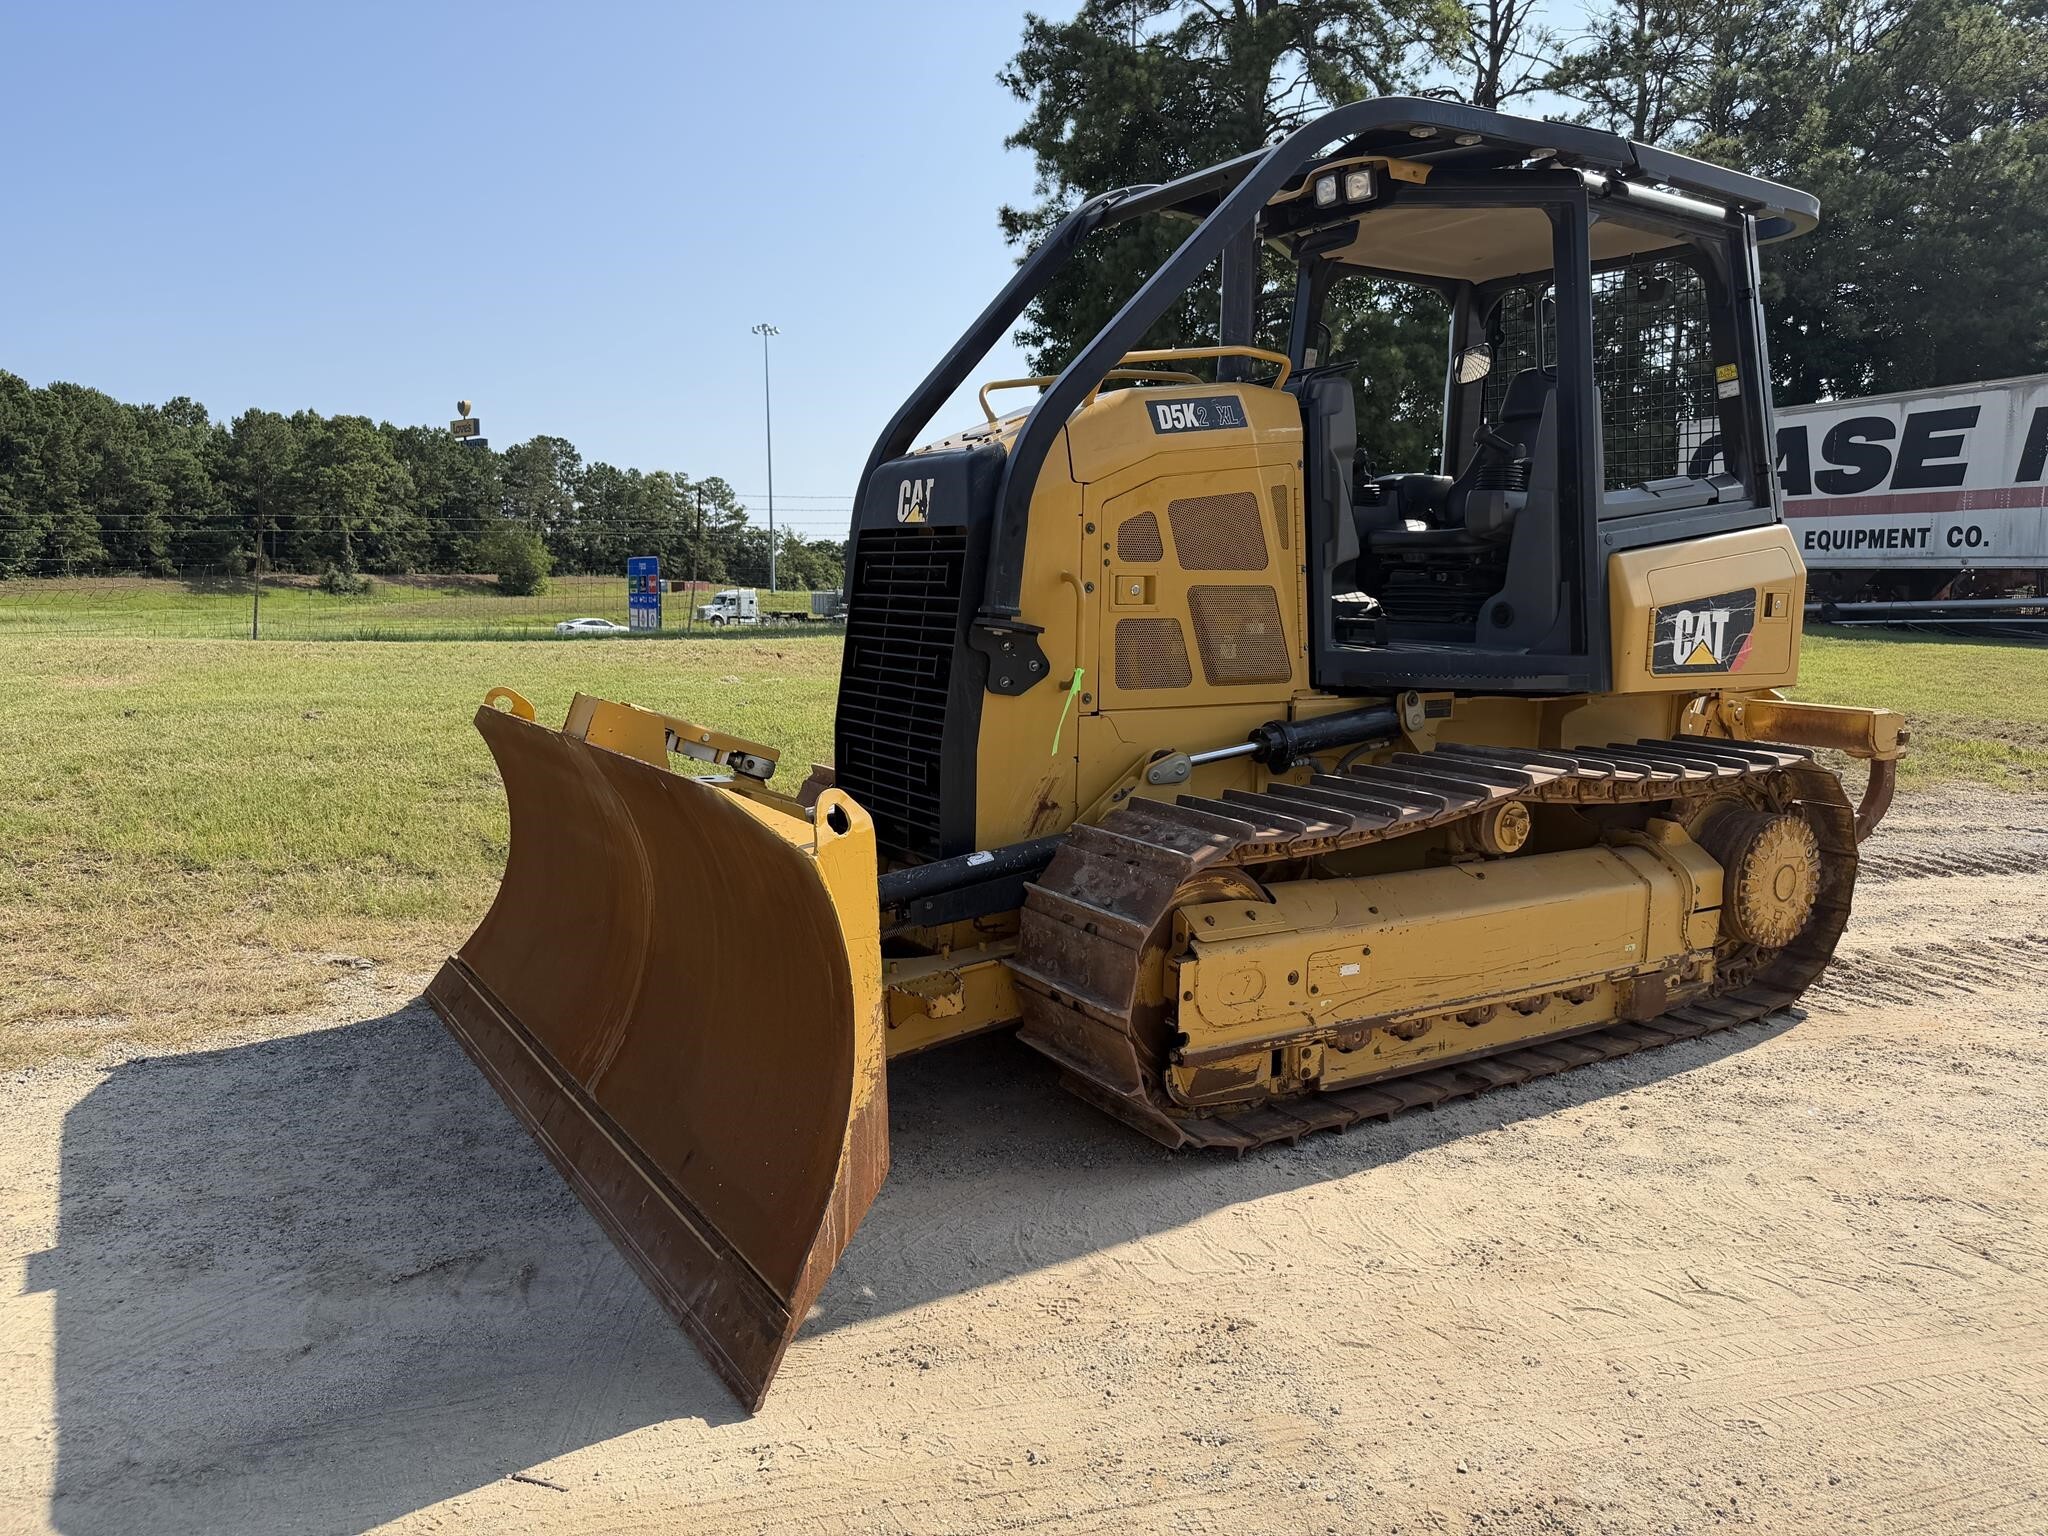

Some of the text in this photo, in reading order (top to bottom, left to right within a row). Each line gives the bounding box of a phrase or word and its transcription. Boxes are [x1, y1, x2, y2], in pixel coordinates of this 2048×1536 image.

[1156, 402, 1239, 430] D5K2 XL
[897, 478, 935, 523] CAT
[1804, 525, 1989, 551] EQUIPMENT CO.
[1673, 609, 1730, 665] CAT
